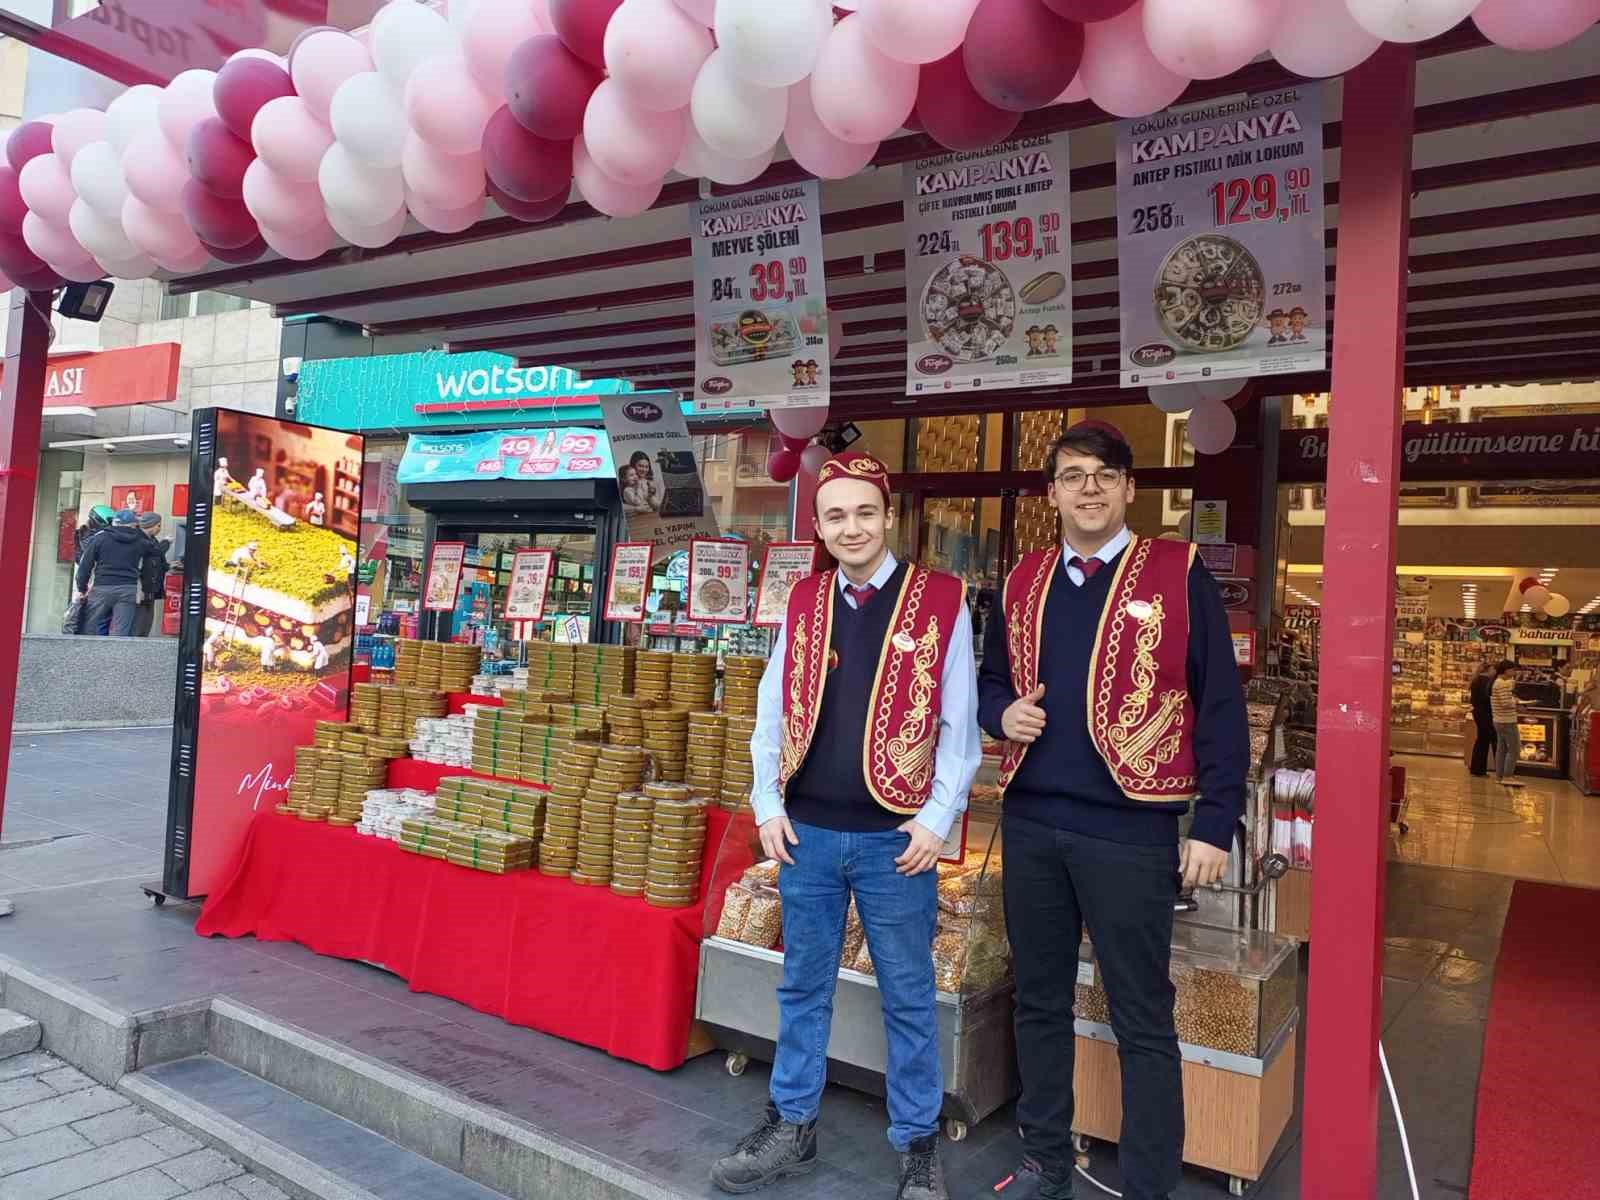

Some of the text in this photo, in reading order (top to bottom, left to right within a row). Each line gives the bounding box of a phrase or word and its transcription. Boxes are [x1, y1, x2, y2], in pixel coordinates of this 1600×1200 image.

[1131, 110, 1301, 164] KAMPANYA
[915, 152, 1053, 195] KAMPANYA
[1133, 168, 1170, 186] ANTEP
[1174, 157, 1223, 177] FISTIKLI
[1256, 142, 1304, 163] LOKUM
[995, 186, 1024, 199] DUBLE
[1025, 179, 1053, 194] ANTEP
[700, 203, 808, 238] KAMPANYA
[952, 200, 1017, 221] FISTIKLI LOKUM
[712, 225, 800, 257] MEYVE ŞÖLENİ
[1405, 431, 1565, 462] gülümseme
